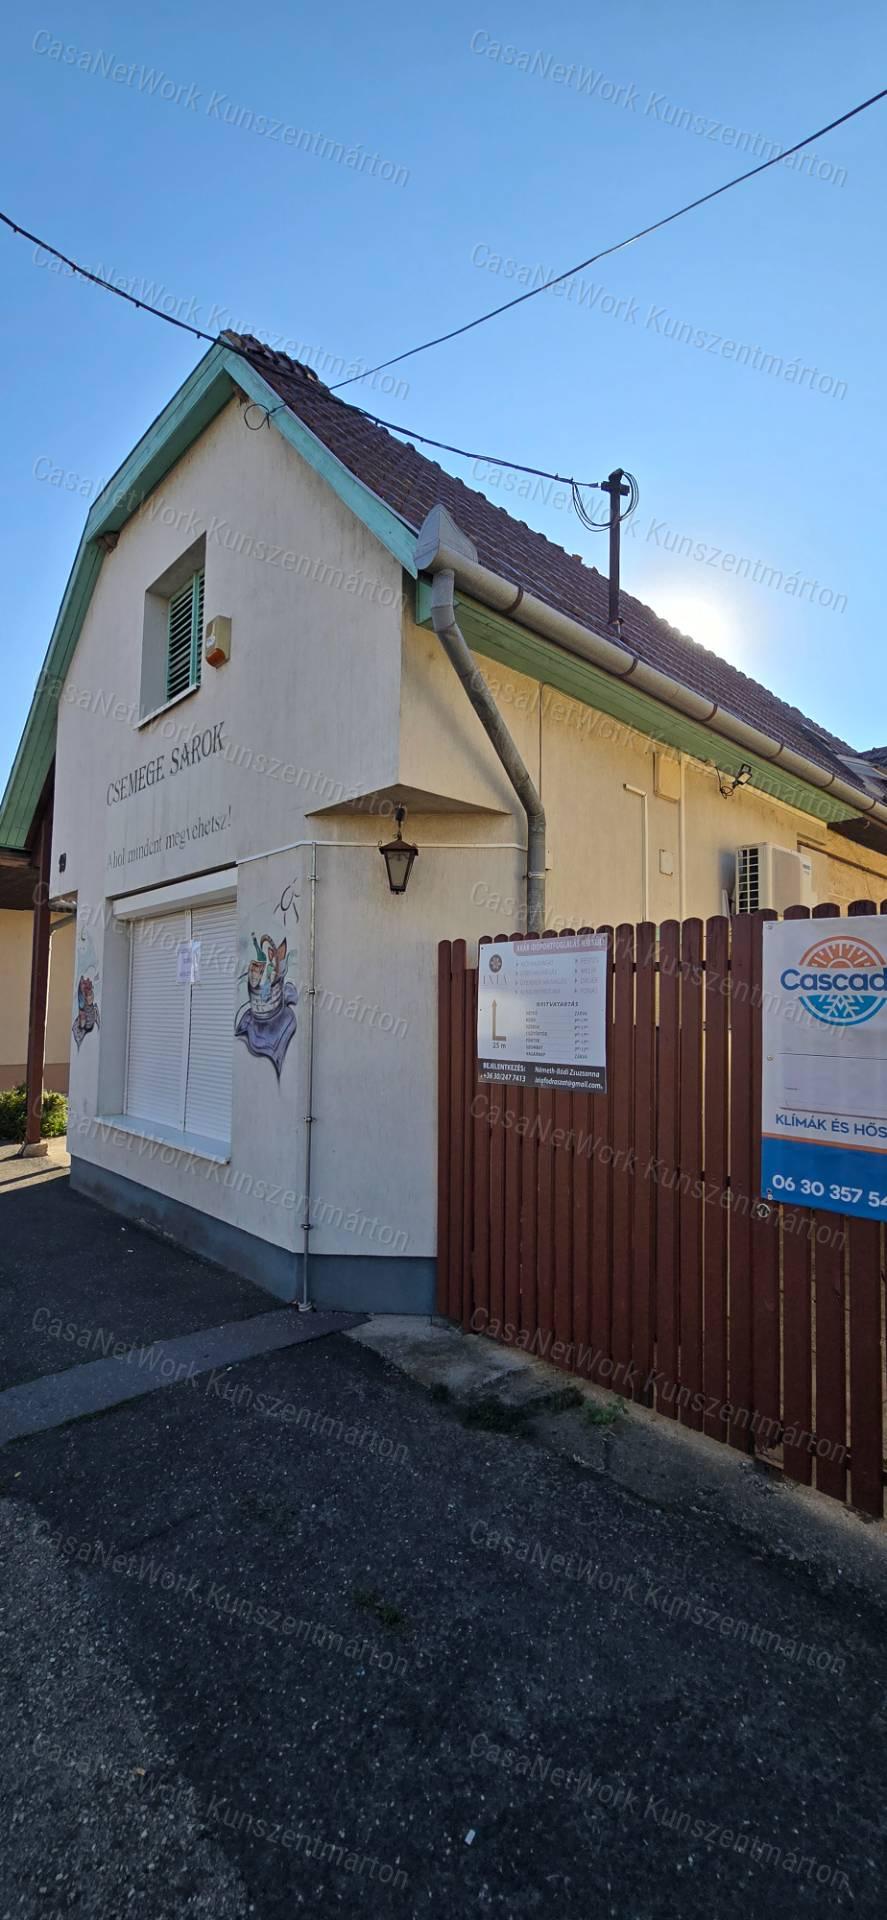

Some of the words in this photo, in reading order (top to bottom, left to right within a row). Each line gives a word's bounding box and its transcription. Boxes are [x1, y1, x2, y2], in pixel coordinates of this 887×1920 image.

[106, 755, 165, 806] CSEMEGE
[170, 721, 225, 776] SAROK
[127, 836, 162, 863] mindent
[165, 805, 231, 850] megvehetsz!
[780, 967, 887, 992] Cascad
[775, 1113, 827, 1131] KLÍMÁK
[831, 1118, 849, 1134] ÉS
[854, 1122, 887, 1138] HŐS
[772, 1174, 796, 1191] 06
[800, 1179, 824, 1196] 30
[829, 1184, 863, 1203] 357
